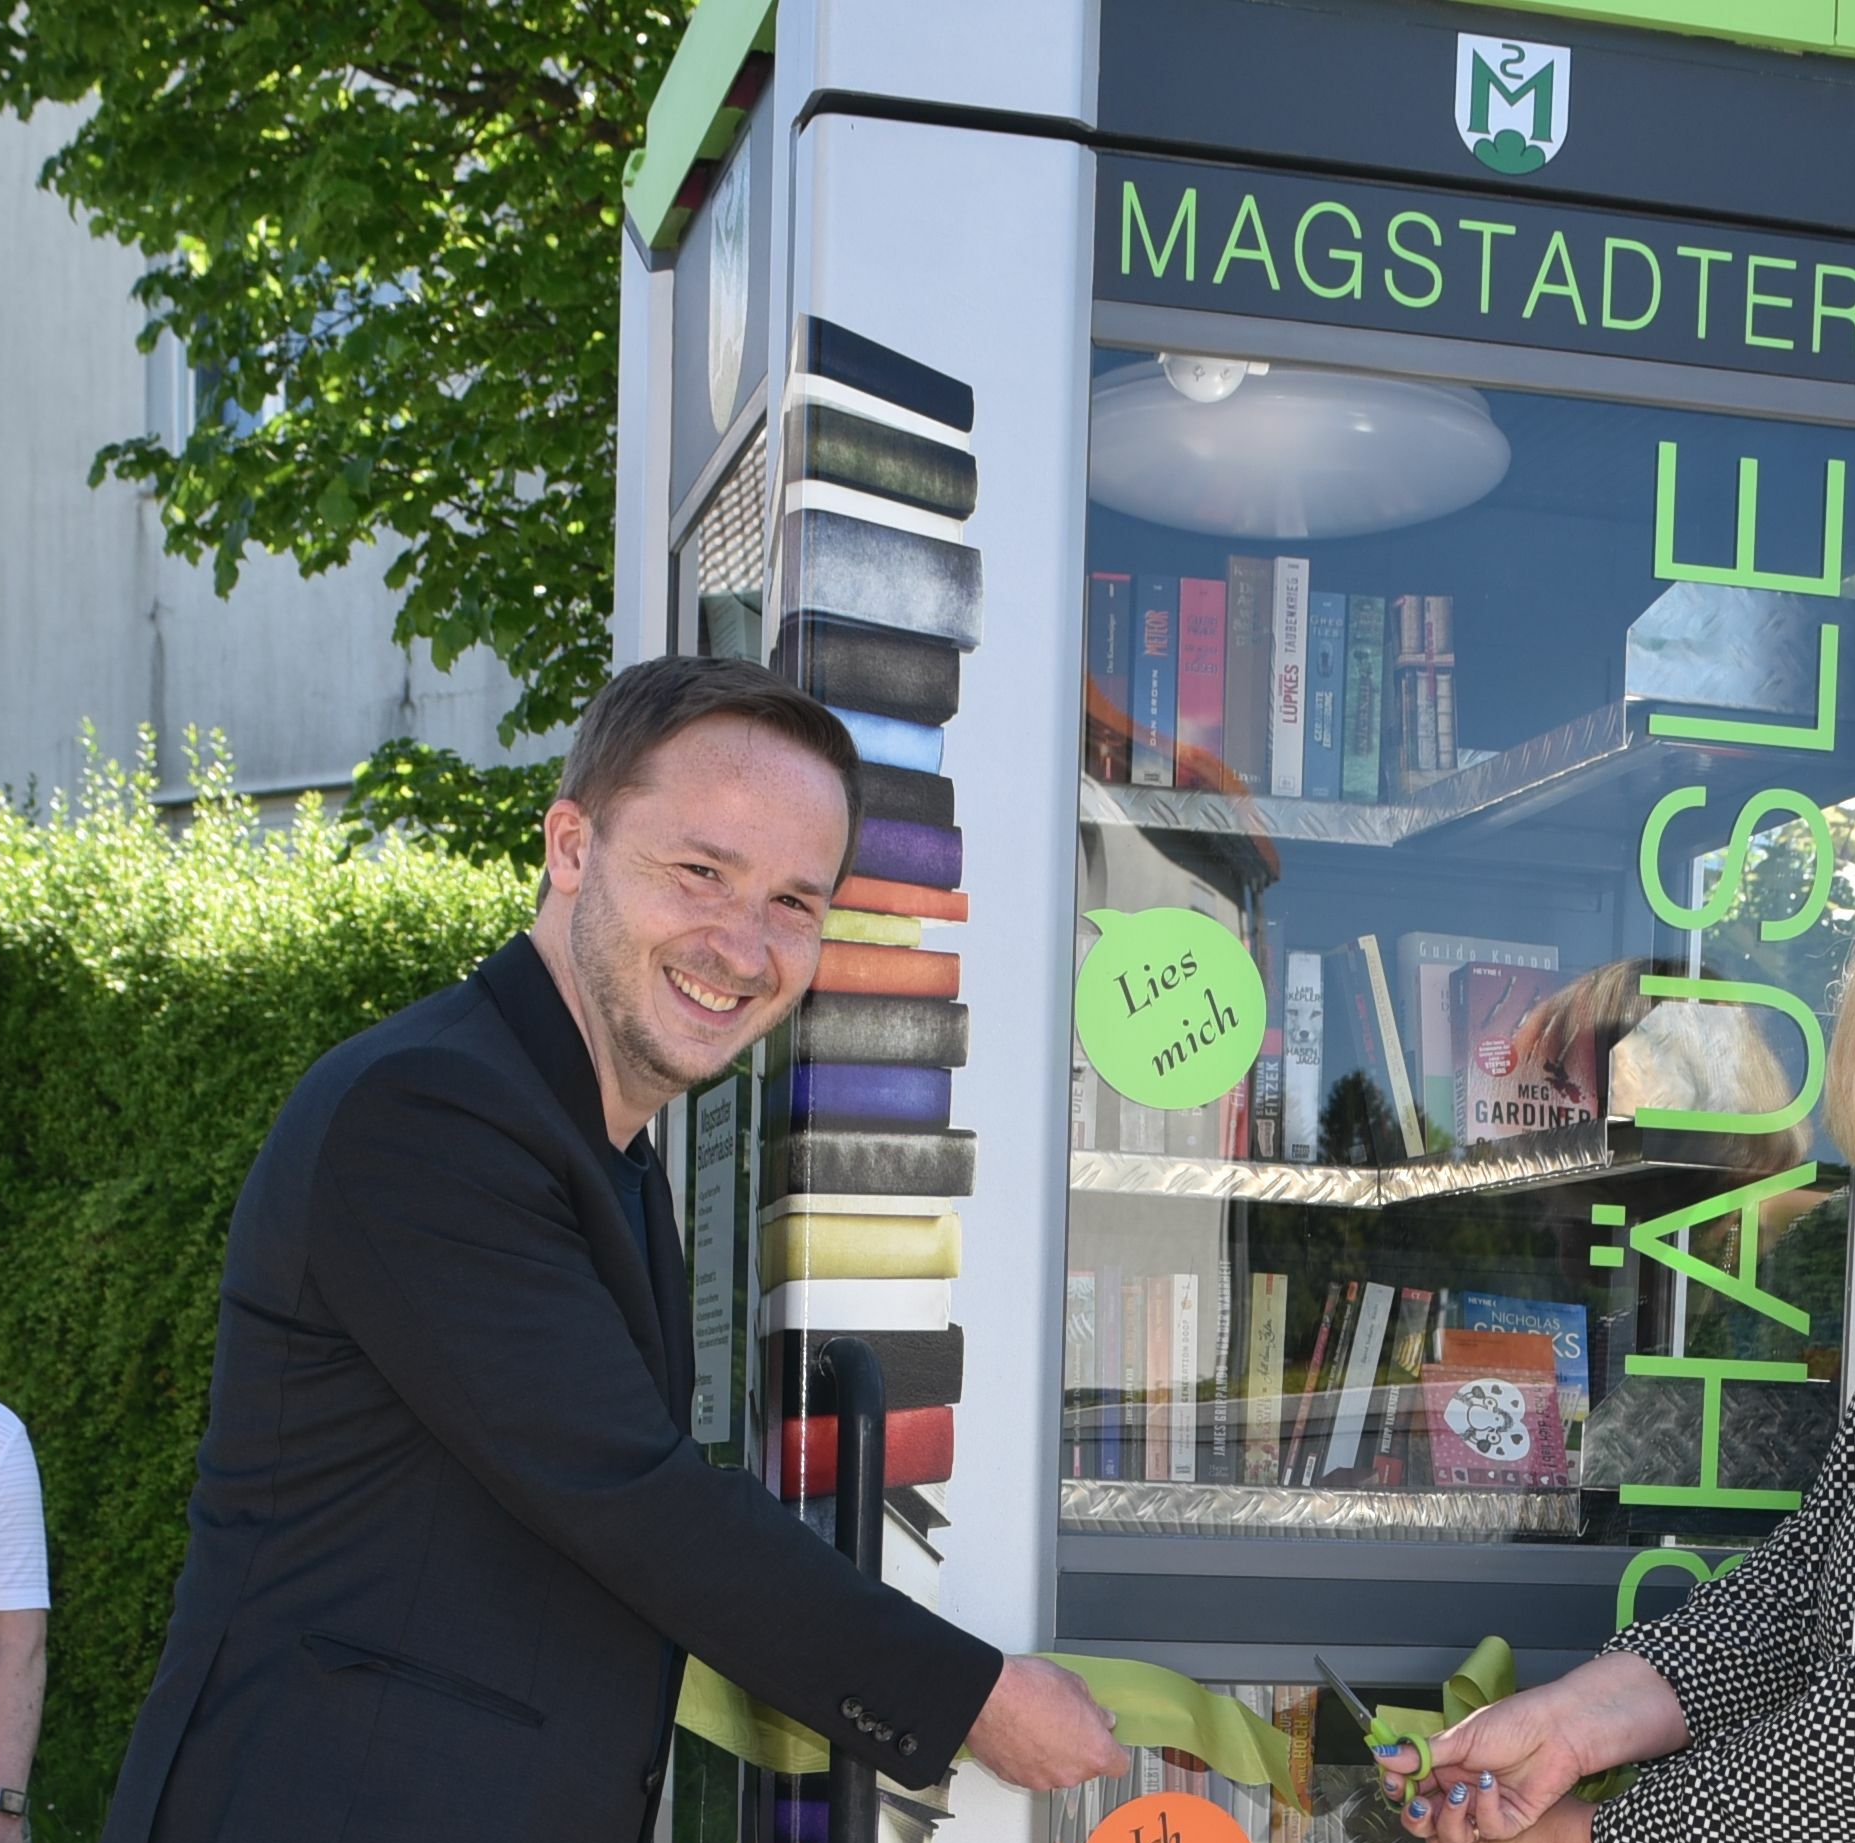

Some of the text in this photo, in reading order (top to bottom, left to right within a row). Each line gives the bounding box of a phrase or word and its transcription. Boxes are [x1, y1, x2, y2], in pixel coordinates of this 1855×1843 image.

[1143, 609, 1169, 657] METEOR
[1284, 576, 1300, 655] TAUBENKRIEG
[1149, 668, 1159, 747] DAN BROWN
[1282, 664, 1300, 725] LÜPKES
[1419, 941, 1476, 961] Guido
[1112, 948, 1199, 1020] Lies
[1151, 987, 1240, 1077] mich
[1265, 1061, 1280, 1117] FITZEK
[1474, 1099, 1591, 1128] GARDINER
[1518, 1083, 1550, 1101] MEG
[1491, 1311, 1561, 1330] NICHOLAS
[1181, 1343, 1190, 1404] GENERATION
[1214, 1364, 1229, 1422] GRIPPANDO
[1213, 1424, 1226, 1457] JAMES
[1293, 1715, 1310, 1760] HOCH
[1297, 1760, 1309, 1785] WILL
